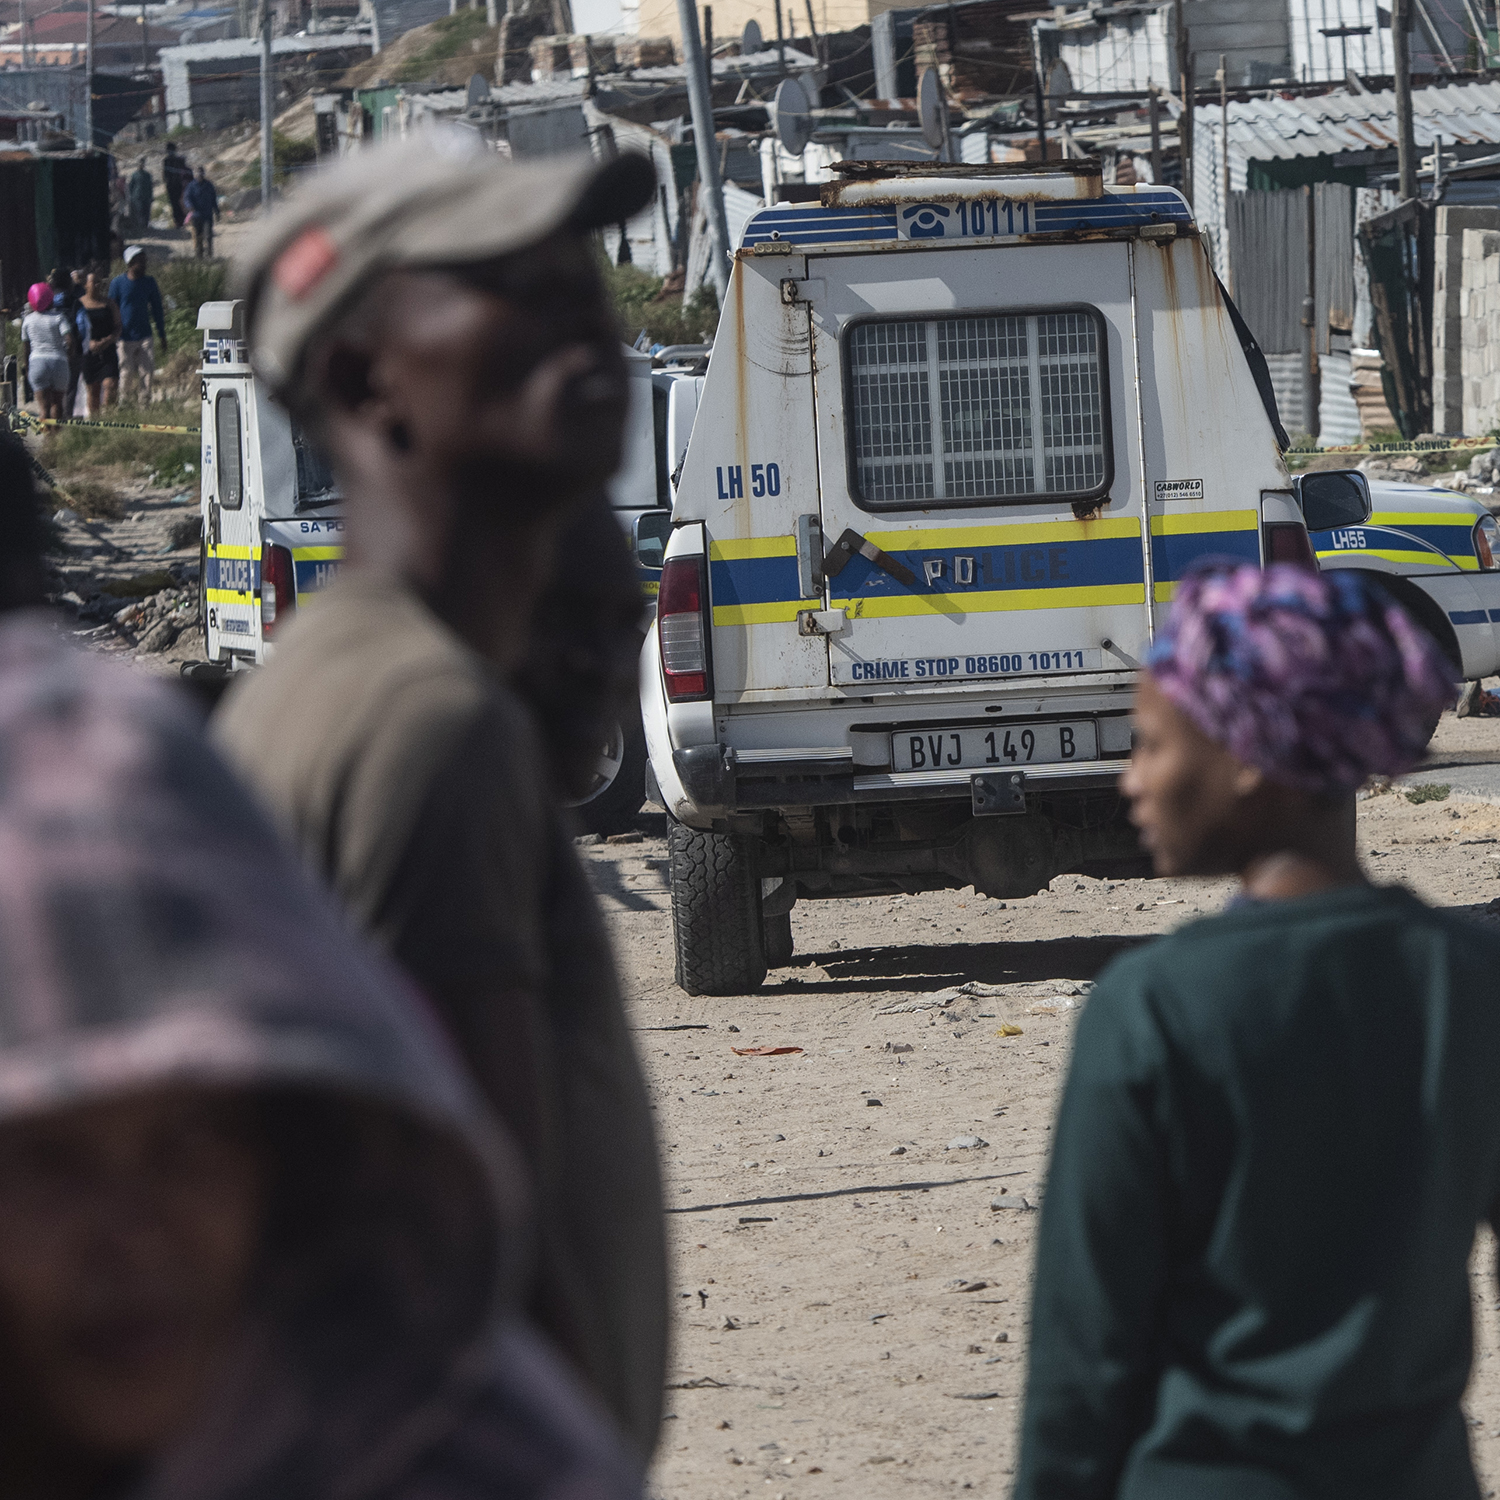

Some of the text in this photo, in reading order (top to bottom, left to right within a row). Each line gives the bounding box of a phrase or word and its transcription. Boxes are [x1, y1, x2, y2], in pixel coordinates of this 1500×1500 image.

[955, 200, 1029, 236] 10111
[1369, 440, 1450, 453] SA POLICE SERVICE
[716, 462, 780, 499] LH 50
[1157, 481, 1200, 491] CABWORLD
[301, 522, 320, 533] SA
[1332, 530, 1366, 549] LH55
[219, 560, 249, 589] POLICE
[923, 548, 1070, 587] POLICE
[852, 651, 1084, 680] CRIME STOP 08600 10111
[910, 727, 1076, 768] BVJ 149 B
